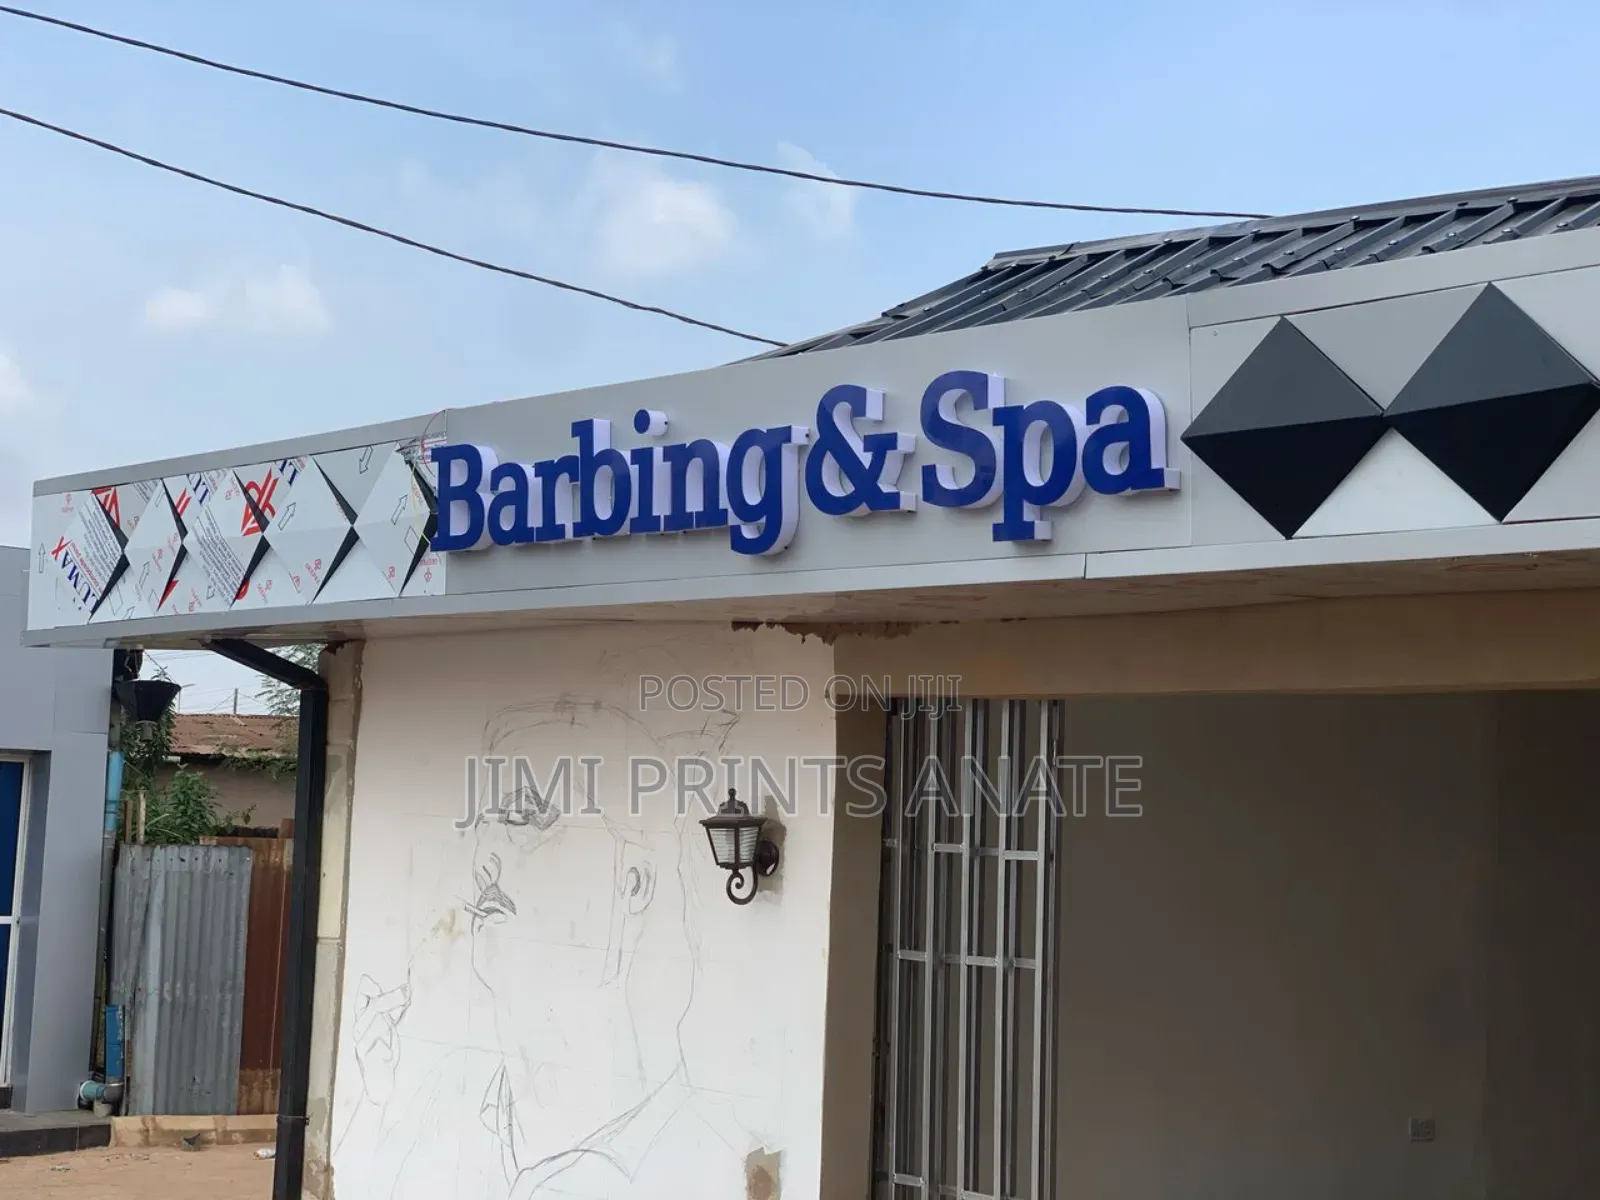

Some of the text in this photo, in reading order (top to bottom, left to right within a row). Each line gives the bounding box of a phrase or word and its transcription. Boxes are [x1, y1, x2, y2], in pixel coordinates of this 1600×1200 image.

[430, 371, 1181, 556] Barbing & Spa
